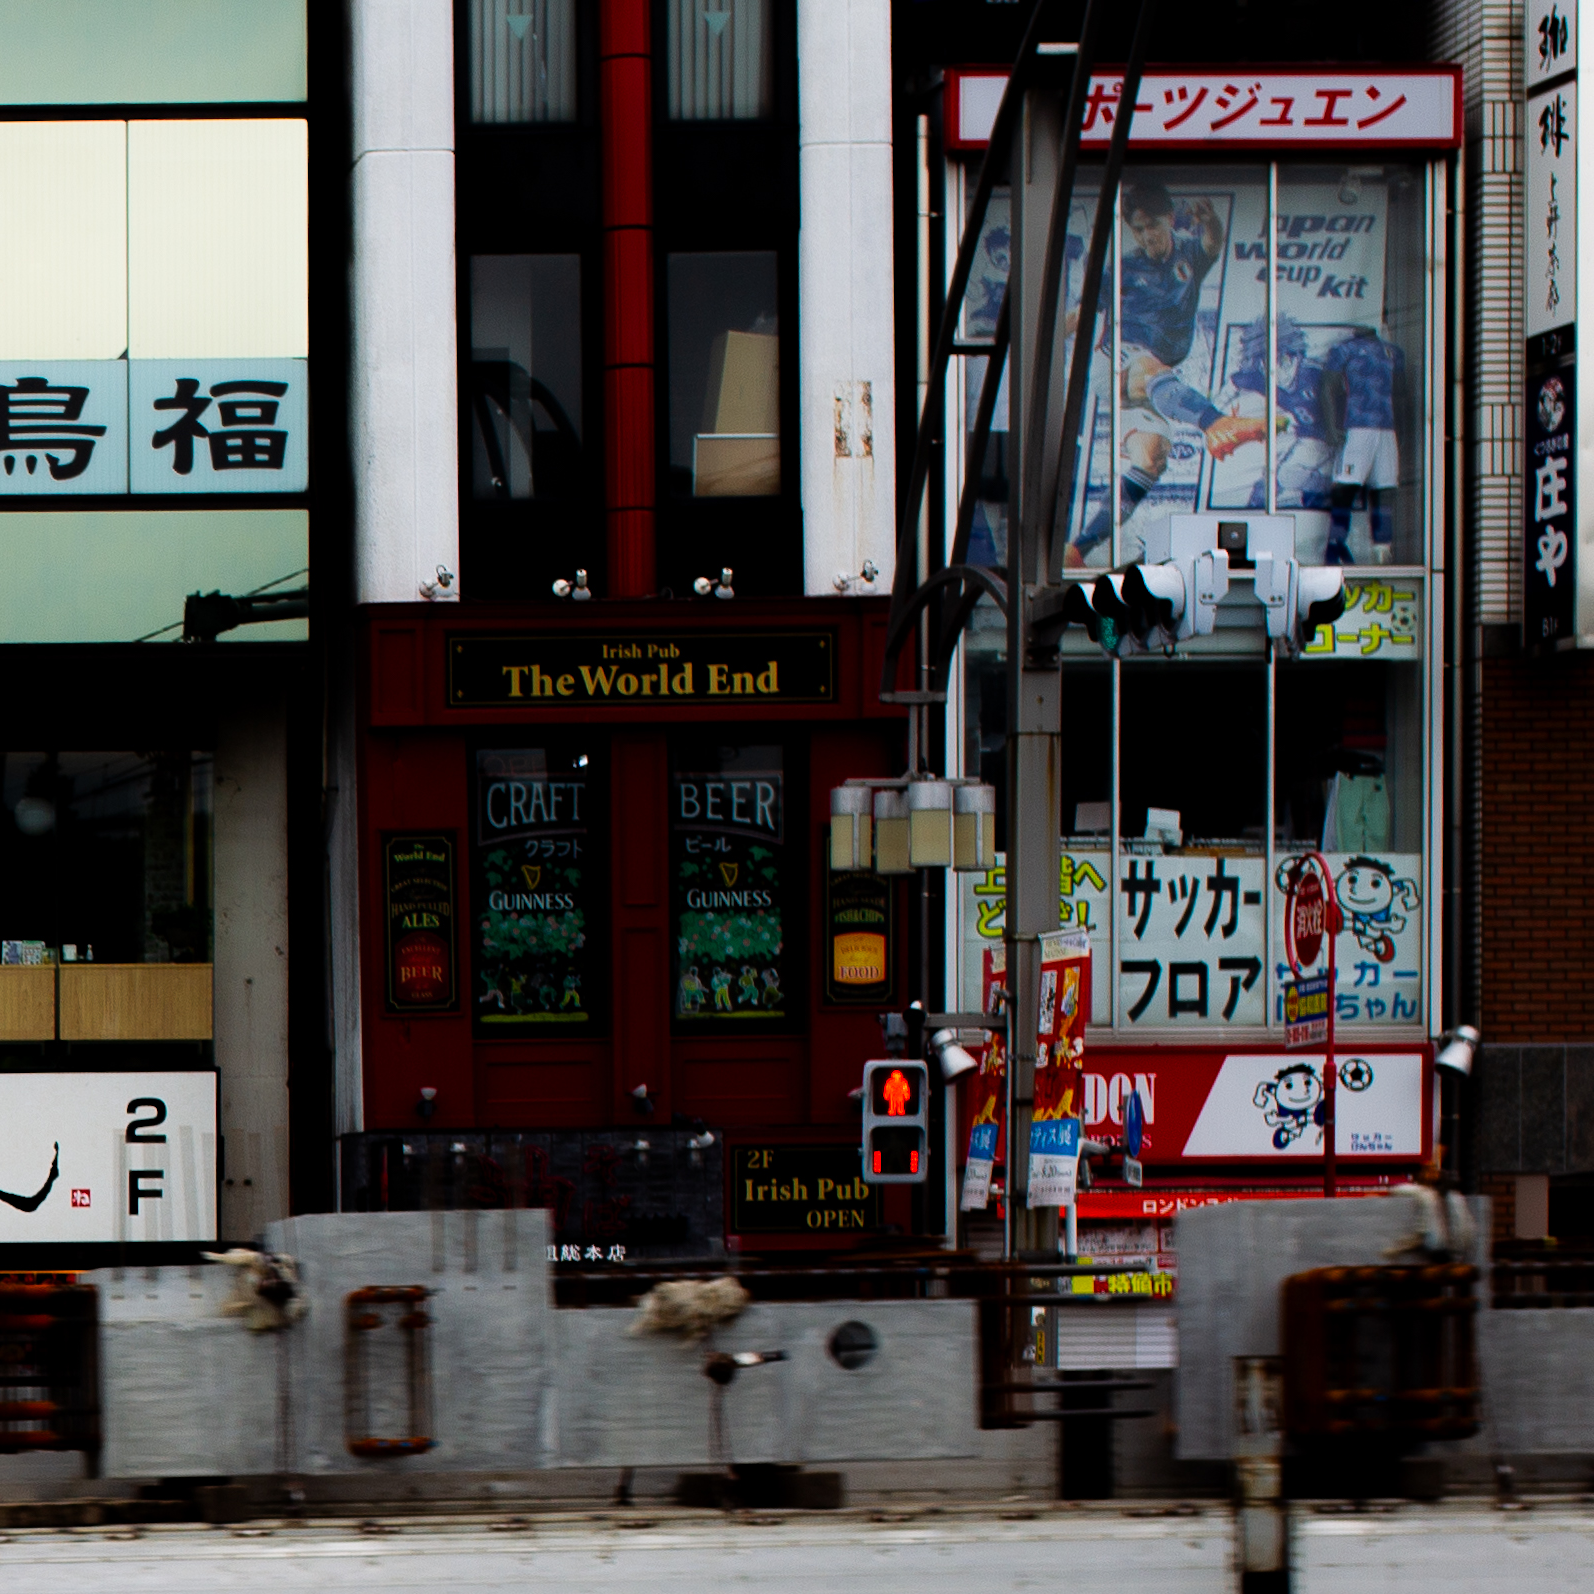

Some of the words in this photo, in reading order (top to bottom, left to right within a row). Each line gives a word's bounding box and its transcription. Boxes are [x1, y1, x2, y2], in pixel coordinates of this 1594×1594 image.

[1081, 82, 1407, 133] ポーツジュエン
[1317, 273, 1369, 298] kit
[1345, 580, 1414, 613] ッカー
[1304, 621, 1414, 655] コーナー
[601, 643, 643, 660] Irish
[646, 643, 681, 660] Pub
[502, 664, 576, 698] The
[579, 662, 695, 697] World
[706, 660, 780, 696] End
[486, 781, 586, 830] CRAFT
[679, 780, 776, 832] BEER
[524, 837, 584, 860] クラフト
[684, 835, 733, 855] ビール
[488, 888, 575, 911] GUINNESS
[686, 887, 773, 910] GUINNESS
[1121, 857, 1262, 942] サッカー
[401, 911, 441, 930] ALES
[400, 965, 443, 984] BEER
[838, 965, 881, 980] FOOD
[1120, 955, 1264, 1023] フロア
[746, 1148, 775, 1170] 2F
[744, 1176, 809, 1202] Irish
[816, 1175, 870, 1201] Pub
[805, 1208, 866, 1230] OPEN
